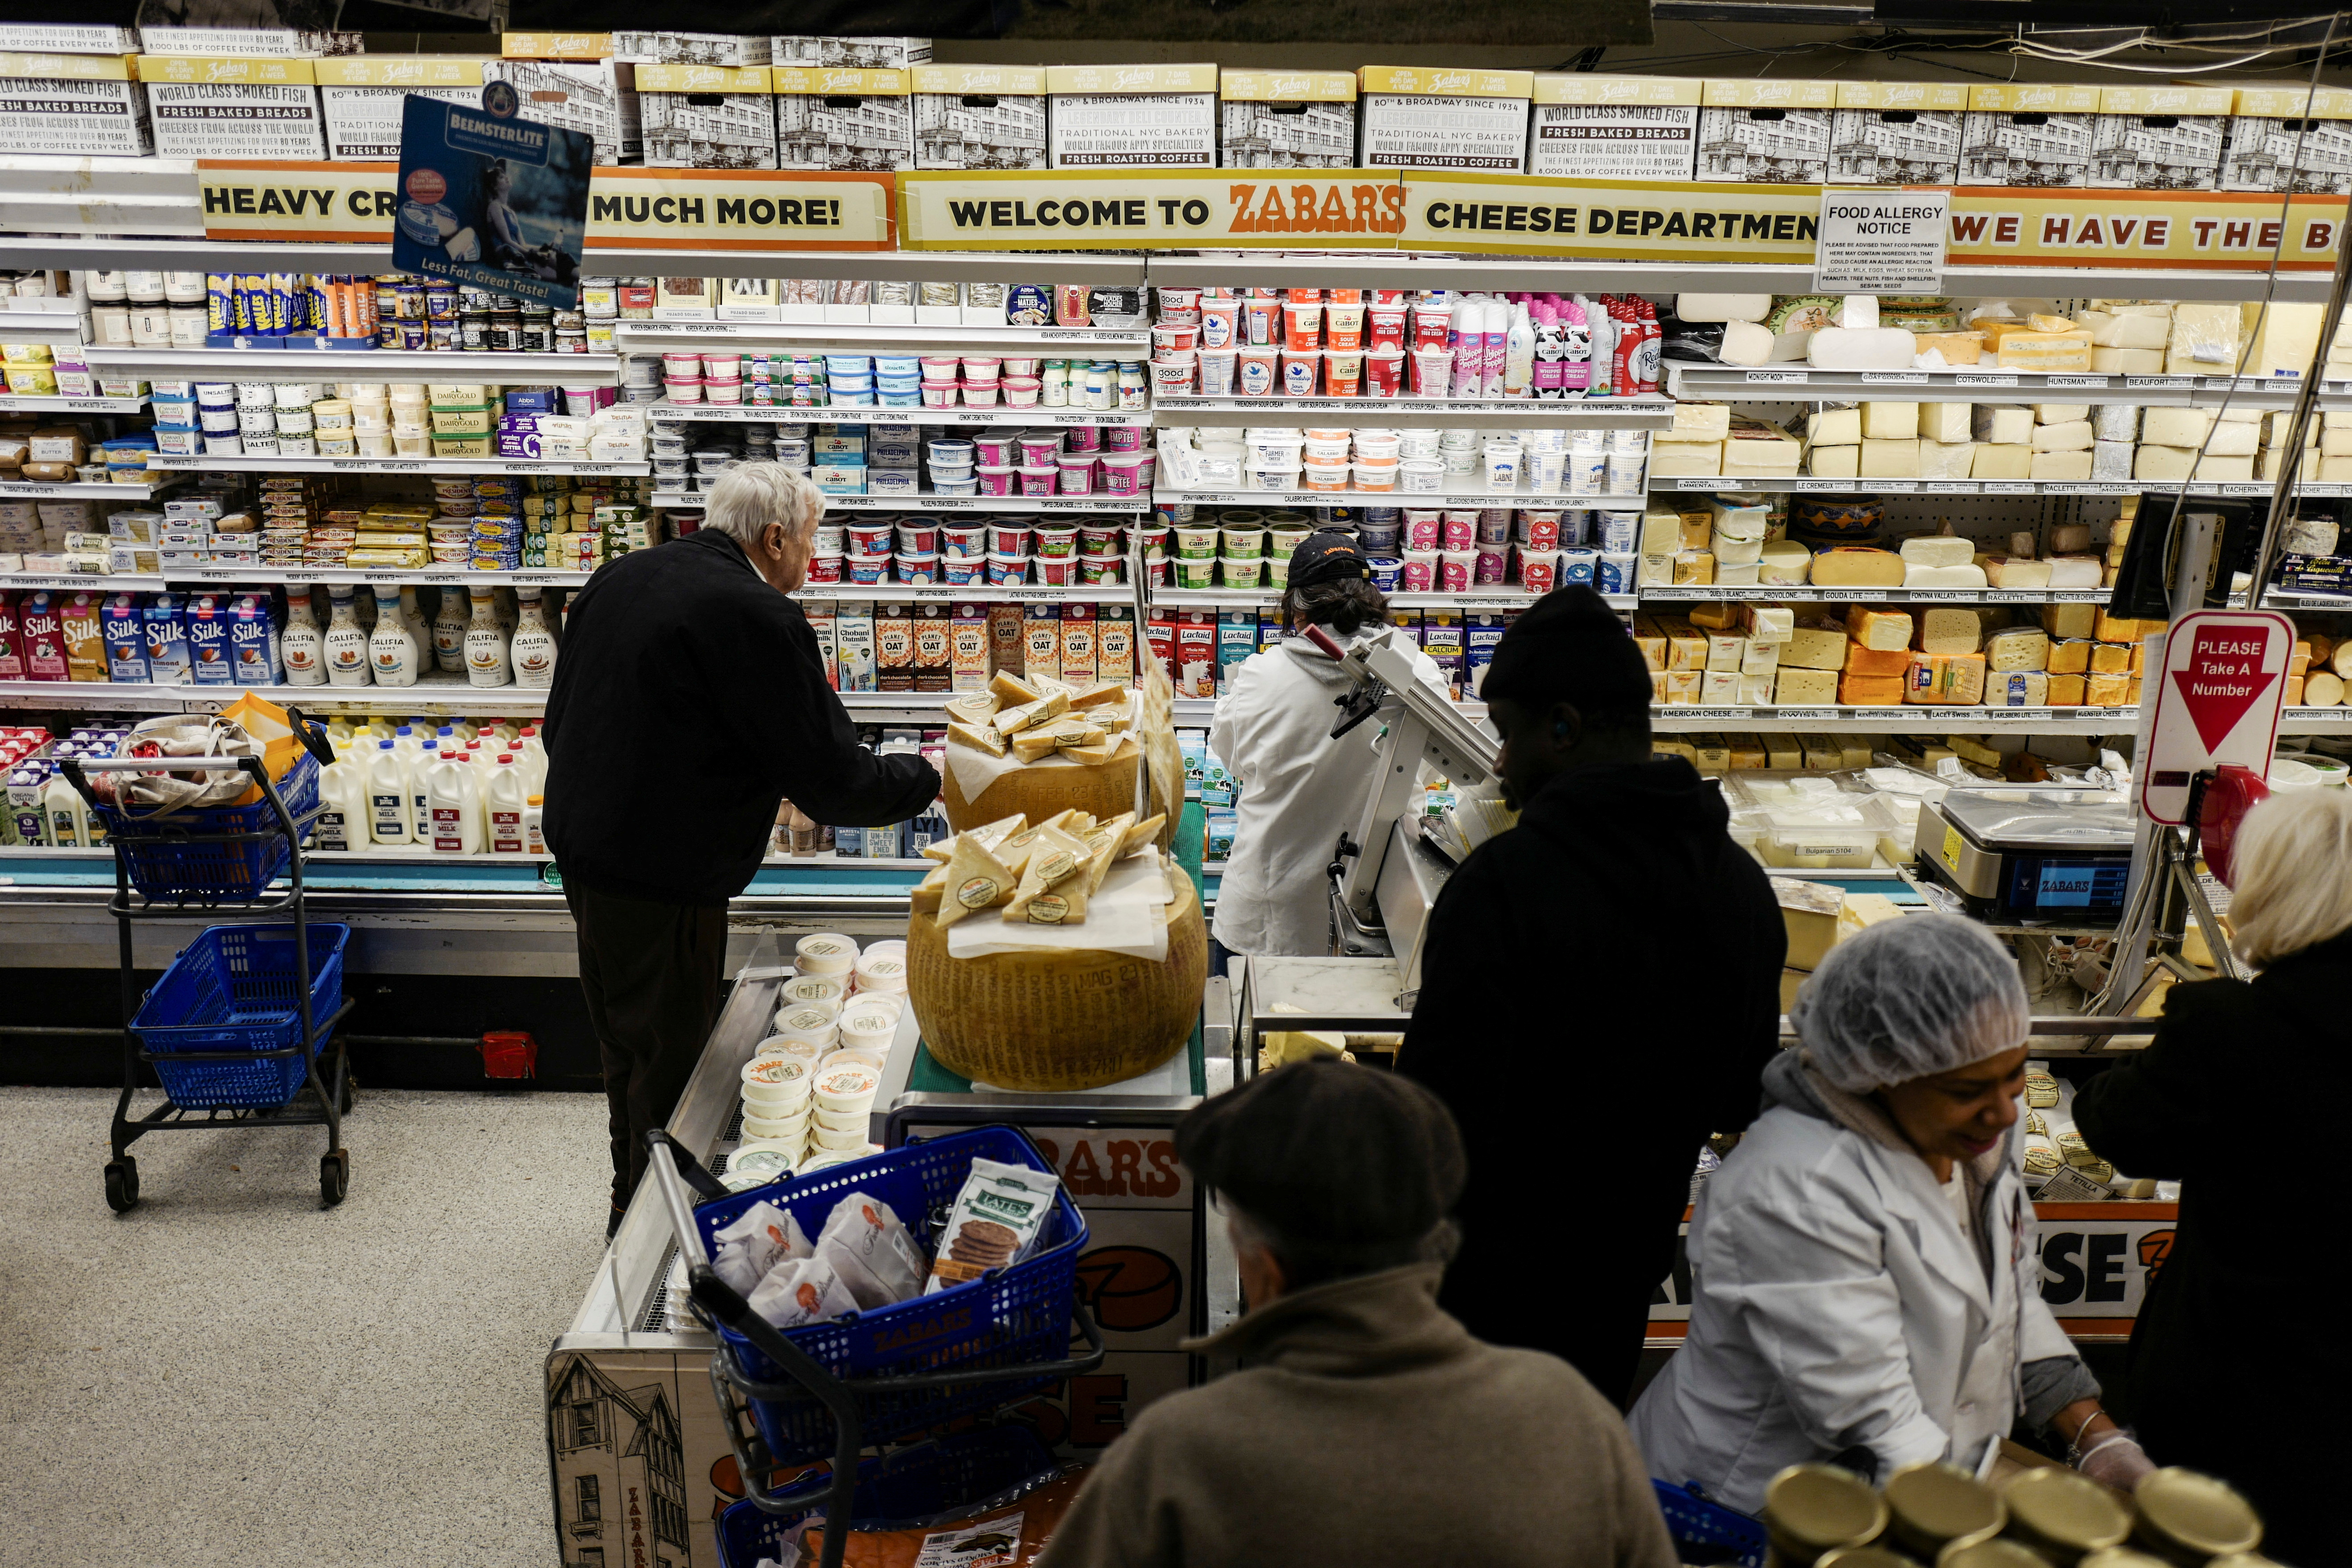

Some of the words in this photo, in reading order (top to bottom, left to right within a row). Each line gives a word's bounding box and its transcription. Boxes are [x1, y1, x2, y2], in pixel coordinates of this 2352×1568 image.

[156, 86, 196, 102] WORLD
[198, 85, 232, 99] CLASS
[235, 85, 279, 100] SMOKED
[282, 88, 306, 103] FISH
[1092, 96, 1147, 104] BROADWAY
[1185, 97, 1205, 105] 1934
[164, 107, 204, 117] FRESH
[209, 108, 252, 117] BAKED
[257, 108, 306, 118] BREADS
[159, 122, 198, 133] CHEESES
[201, 123, 226, 134] FROM
[228, 123, 262, 134] ACROSS
[264, 123, 282, 134] THE
[283, 123, 313, 134] WORLD
[1059, 129, 1135, 137] TRADITIONAL
[1166, 128, 1210, 136] BAKERY
[167, 137, 180, 145] THE
[181, 137, 205, 145] FINEST
[280, 137, 289, 145] 80
[1064, 140, 1092, 151] WORLD
[1096, 140, 1127, 150] FAMOUS
[1130, 140, 1149, 150] APPY
[1153, 139, 1203, 150] SPECIALTIES
[1067, 155, 1101, 164] FRESH
[1106, 155, 1156, 163] ROASTED
[1160, 154, 1203, 162] COFFEE
[204, 188, 334, 215] HEAVY
[593, 195, 704, 223] MUCH
[717, 199, 840, 225] MORE!
[1829, 207, 1870, 219] FOOD
[1873, 207, 1943, 219] ALLERGY
[949, 200, 1145, 227] WELCOME
[1158, 200, 1209, 225] TO
[1427, 202, 1577, 233] CHEESE
[1588, 209, 1819, 241] DEPARTMEN
[1857, 222, 1911, 234] NOTICE
[1952, 217, 2018, 242] WE
[2043, 218, 2168, 245] HAVE
[2195, 222, 2281, 247] THE
[422, 257, 447, 272] Less
[450, 263, 471, 283] Fat,
[475, 270, 511, 288] Great
[513, 278, 549, 298] Taste!
[209, 292, 225, 330] KALLES
[1158, 368, 1183, 377] good
[25, 617, 59, 637] Silk
[107, 620, 141, 641] Silk
[1182, 631, 1212, 640] Lactaid
[1429, 632, 1458, 641] Lactaid
[371, 638, 404, 646] CALIFIA
[886, 642, 903, 651] OAT
[2198, 641, 2261, 655] PLEASE
[2202, 663, 2235, 675] Take
[2238, 663, 2250, 675] A
[2192, 683, 2252, 697] Number
[1806, 847, 1833, 855] Bulgarian
[2070, 1174, 2097, 1193] TETILLA
[983, 1194, 1029, 1215] TATE'S
